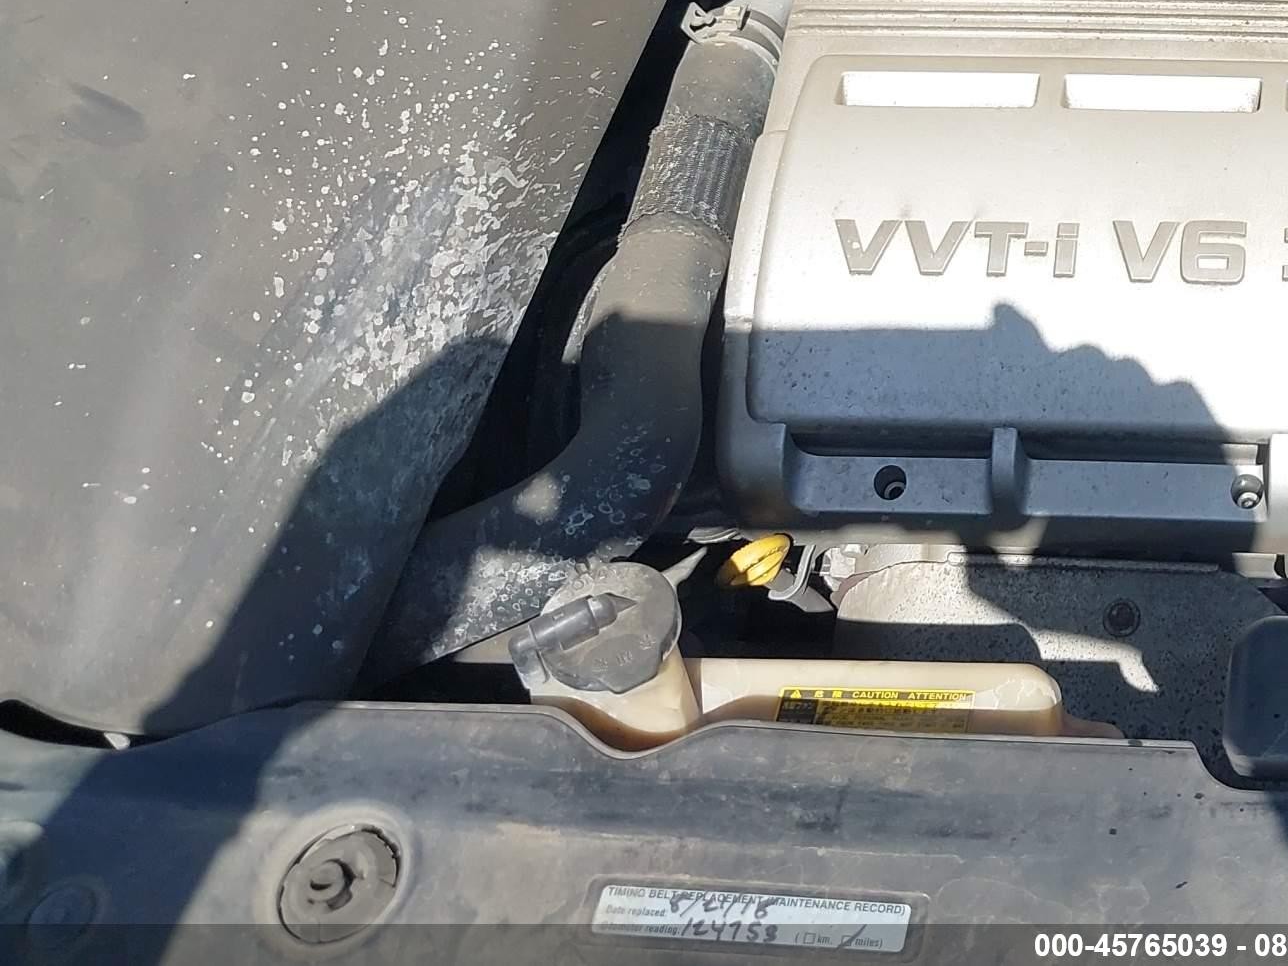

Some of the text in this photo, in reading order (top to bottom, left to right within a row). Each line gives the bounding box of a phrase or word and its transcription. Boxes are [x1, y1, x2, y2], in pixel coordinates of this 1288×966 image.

[834, 219, 1079, 277] VVT-i
[1112, 219, 1248, 285] V6
[852, 691, 898, 699] CAUTION
[908, 692, 967, 700] ATTENTION
[608, 886, 646, 898] TIMING
[854, 903, 905, 915] RECORD)
